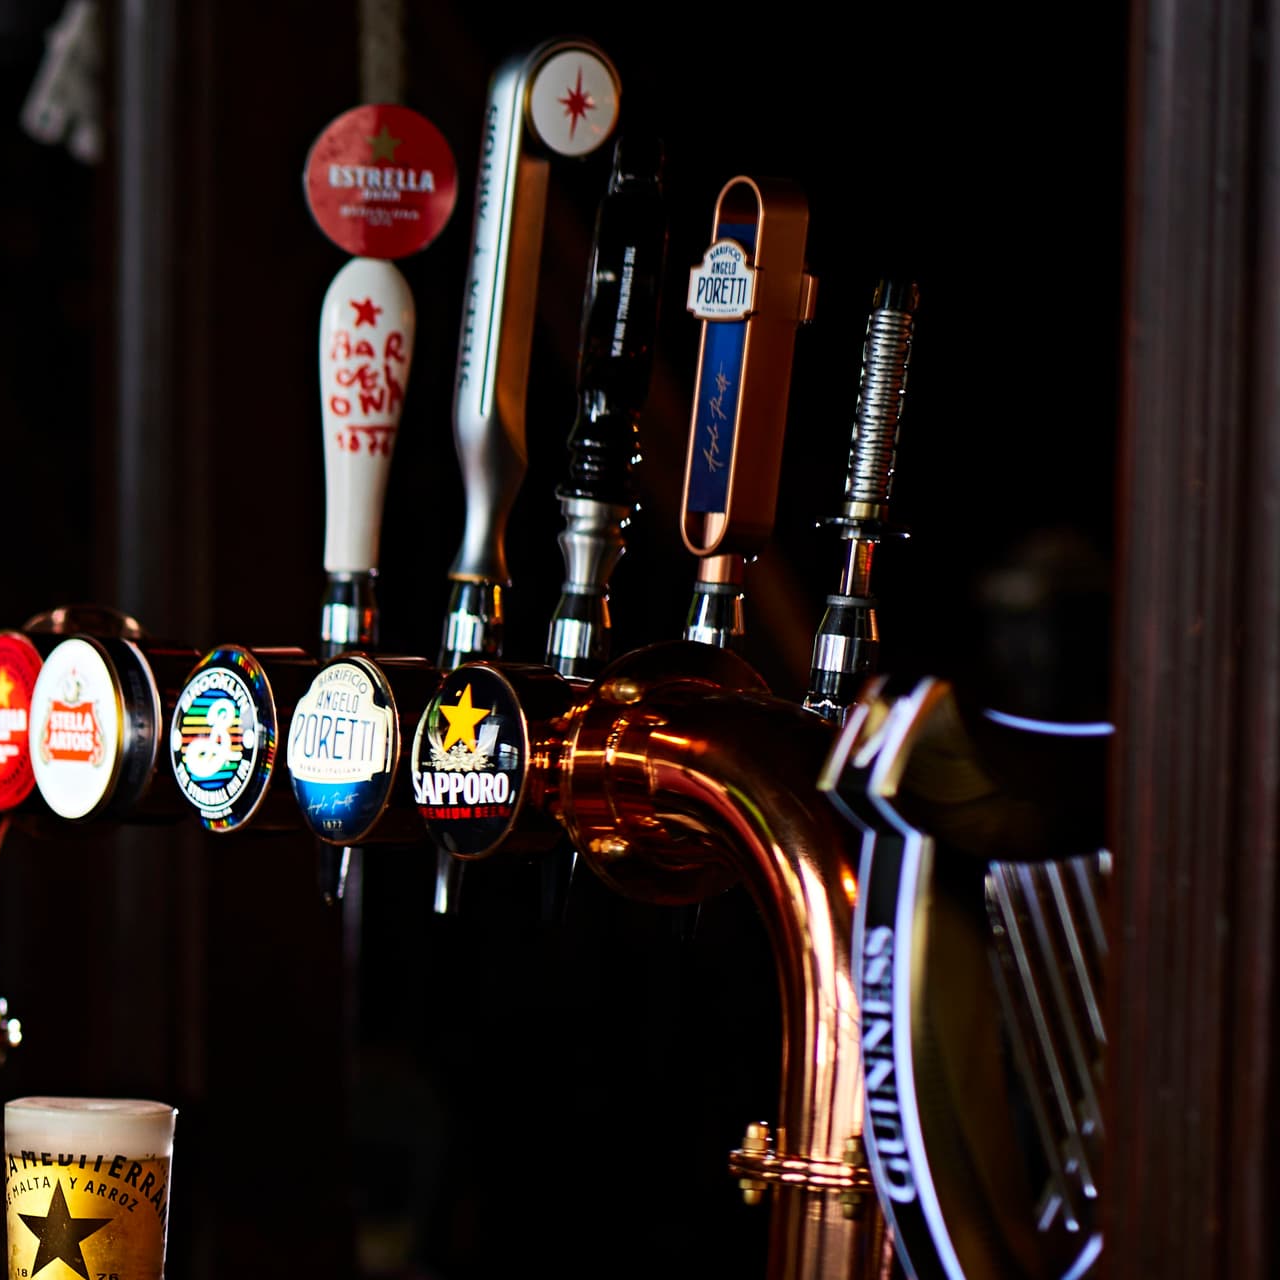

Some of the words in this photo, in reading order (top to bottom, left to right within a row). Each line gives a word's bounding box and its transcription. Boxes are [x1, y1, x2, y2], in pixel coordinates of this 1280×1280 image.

[329, 164, 435, 192] ESTRELLA
[711, 262, 737, 275] ANGELO
[696, 277, 747, 304] PORETTI
[181, 672, 250, 713] BROOKLYN
[318, 670, 368, 694] BIRRIFICIO
[316, 690, 360, 714] ANGELO
[50, 711, 94, 731] STELLA
[49, 731, 94, 751] ARTOIS
[292, 713, 376, 761] PORETTI
[412, 771, 509, 805] SAPPORO
[861, 925, 916, 1203] GUINNESS
[12, 1176, 52, 1199] MALTA
[69, 1177, 78, 1190] Y
[84, 1180, 140, 1213] ARROZ
[16, 1267, 28, 1278] 18
